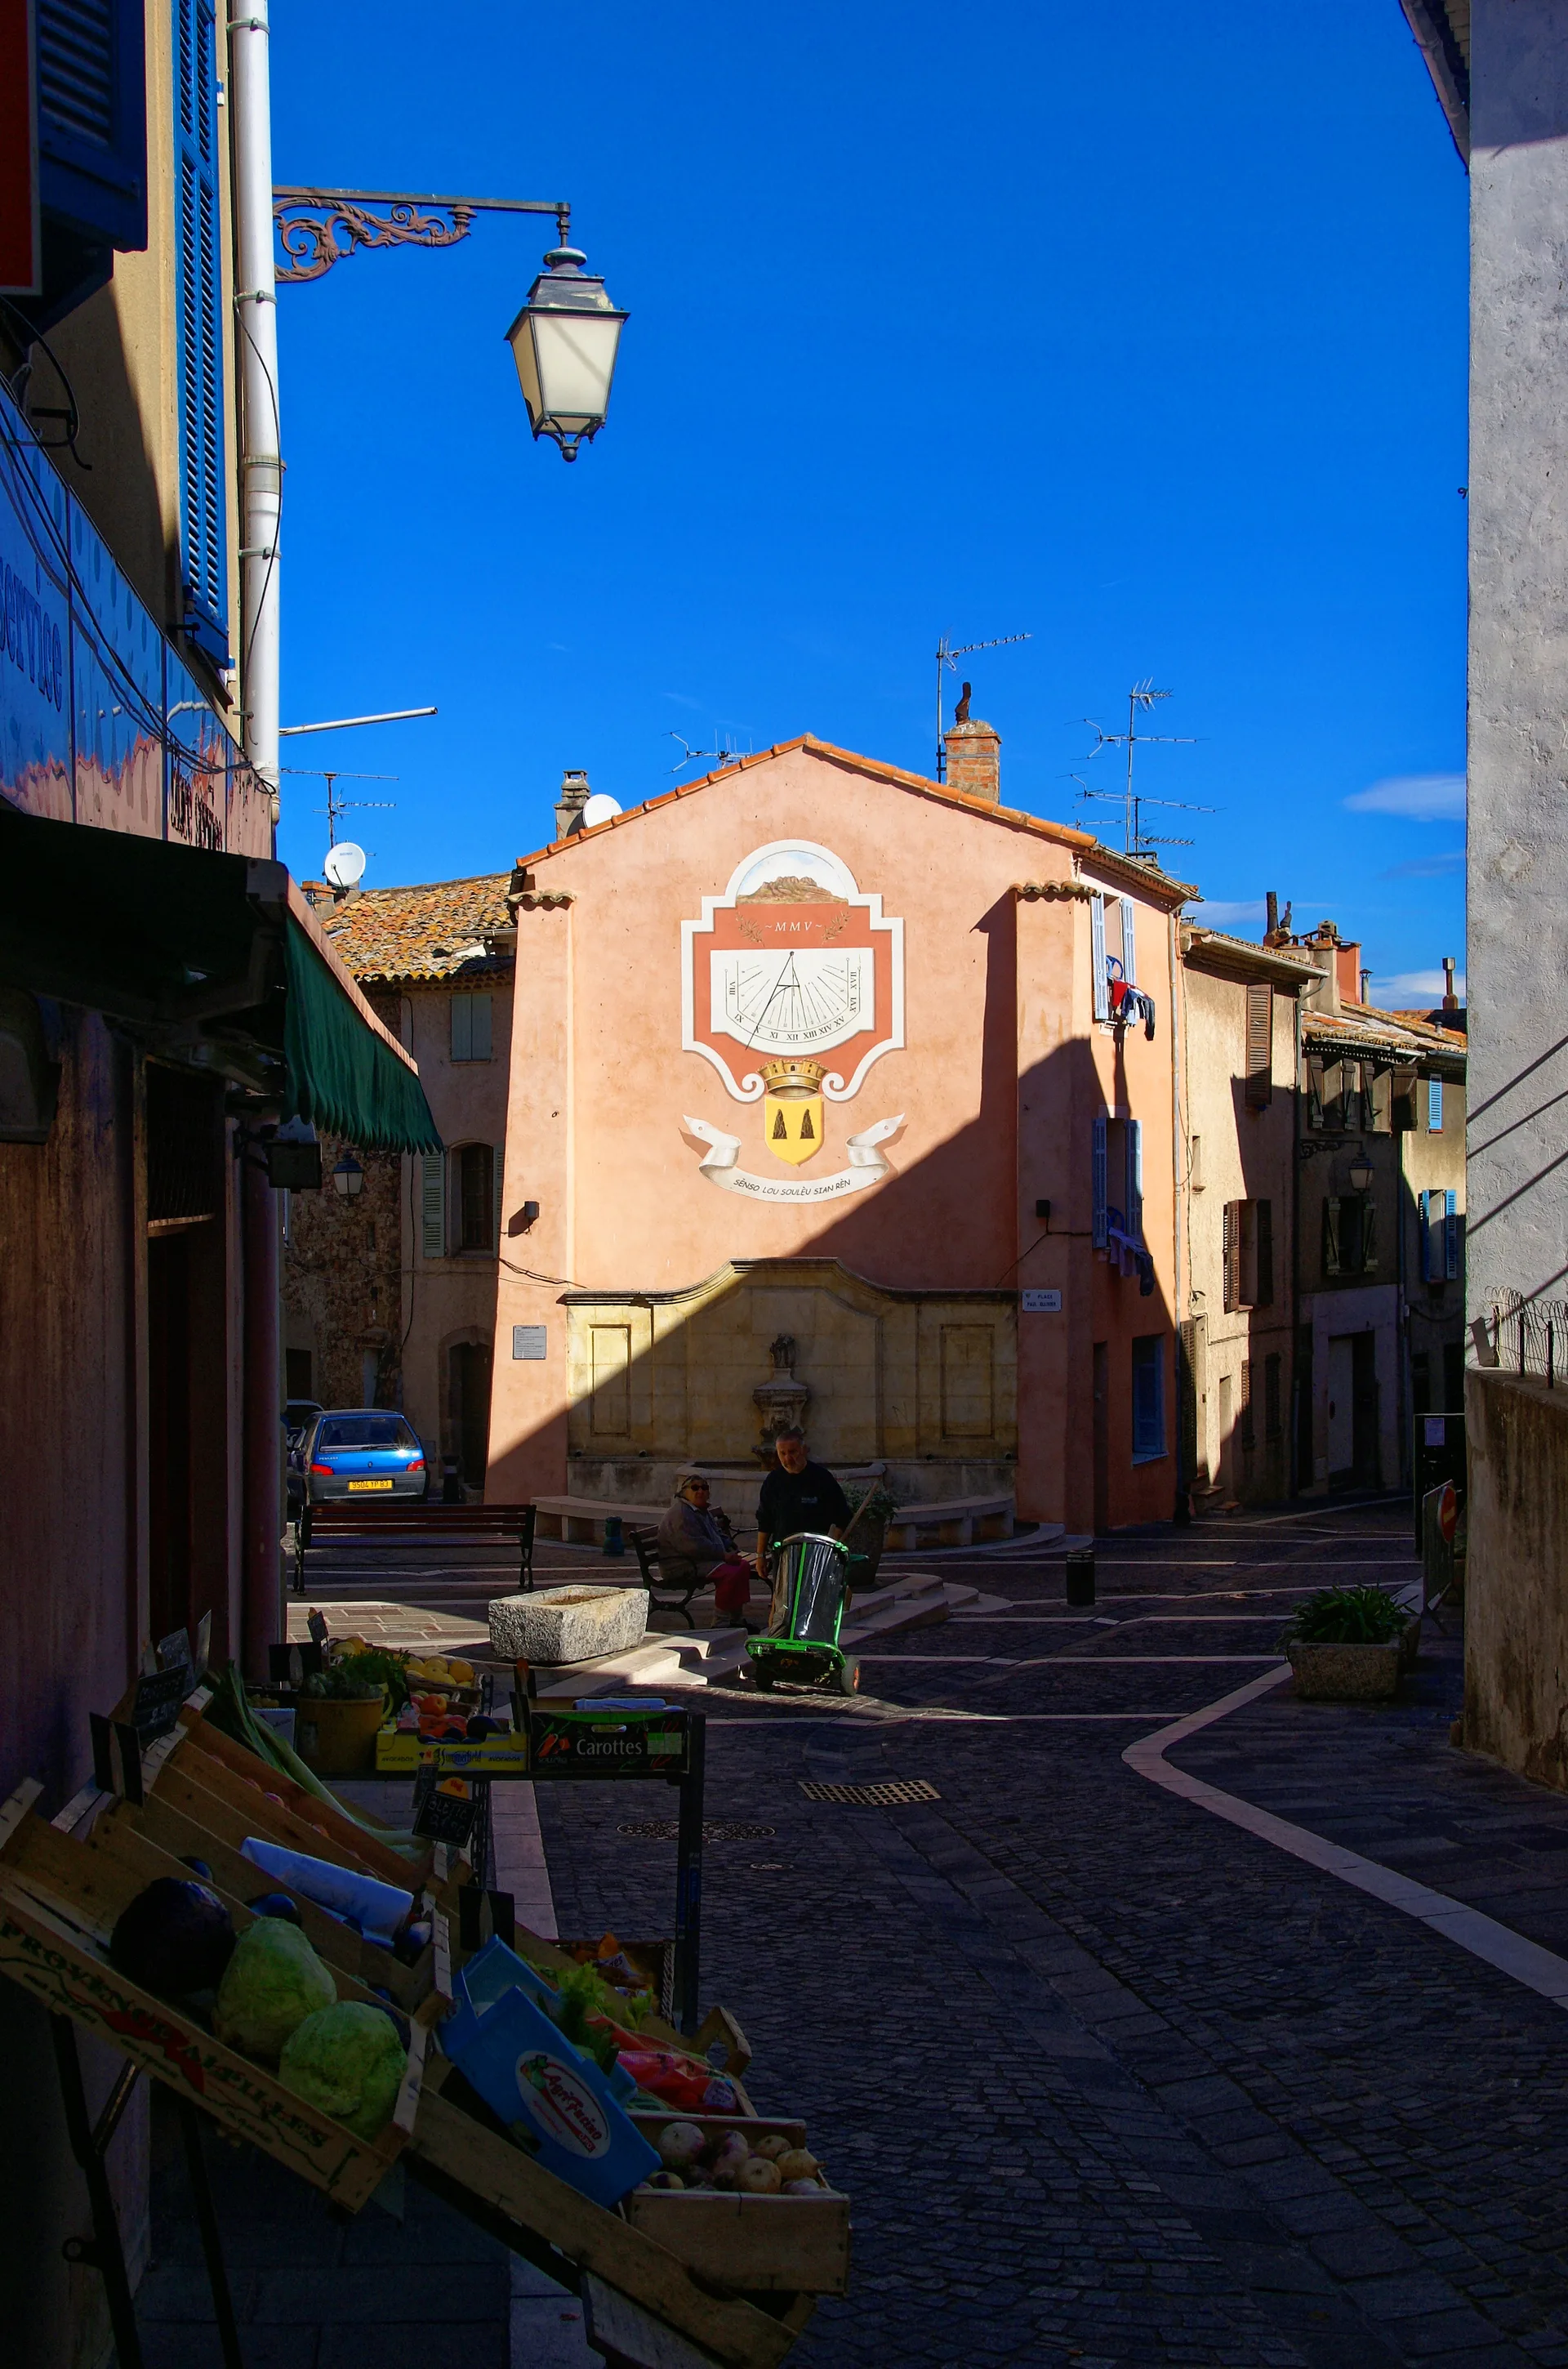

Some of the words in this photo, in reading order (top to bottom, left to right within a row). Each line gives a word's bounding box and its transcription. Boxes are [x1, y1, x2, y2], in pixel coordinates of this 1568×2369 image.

[769, 1031, 778, 1040] XI
[786, 1033, 799, 1041] XII
[803, 1030, 817, 1040] XIII
[818, 1023, 832, 1035] XIV
[833, 1015, 845, 1028] XV
[733, 1178, 760, 1192] SÈNSO
[762, 1186, 780, 1195] LOU
[781, 1186, 812, 1196] SOULÈU
[813, 1184, 834, 1195] SIAN
[835, 1178, 851, 1190] RÈN
[577, 1738, 643, 1756] Carottes
[1, 1921, 176, 2041] PROVENCE
